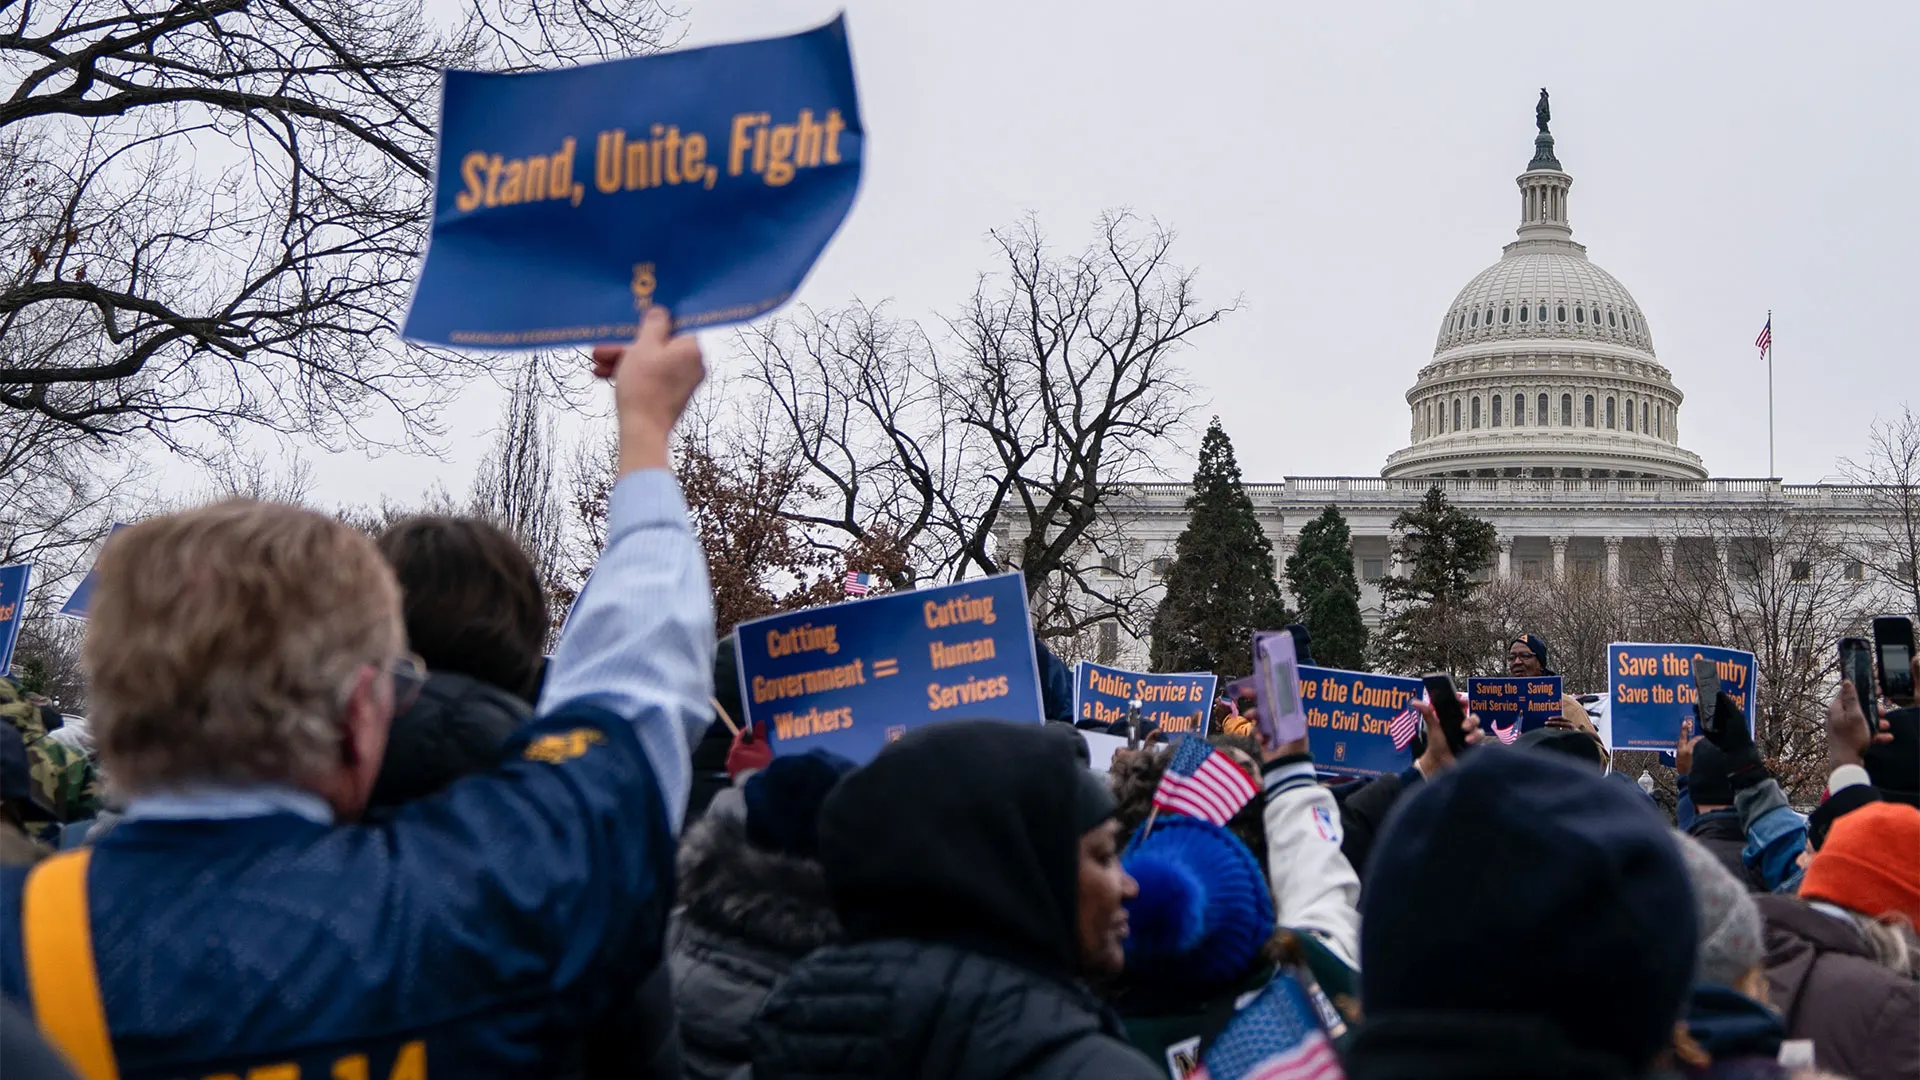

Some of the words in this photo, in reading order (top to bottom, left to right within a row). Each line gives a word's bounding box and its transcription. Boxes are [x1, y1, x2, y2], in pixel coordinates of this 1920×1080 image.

[456, 137, 584, 213] Stand,
[594, 123, 718, 194] Unite,
[728, 108, 846, 187] Fight
[923, 595, 997, 629] Cutting
[767, 623, 839, 658] Cutting
[928, 637, 996, 671] Human
[753, 658, 866, 703] Government
[1618, 652, 1658, 676] Save
[1661, 652, 1689, 677] the
[926, 674, 1009, 712] Services
[1089, 668, 1132, 700] Public
[1134, 679, 1186, 702] Service
[1189, 681, 1204, 702] is
[1299, 679, 1317, 700] ve
[1321, 677, 1348, 703] the
[1351, 680, 1413, 710] Countr
[1476, 682, 1503, 697] Saving
[1504, 682, 1518, 695] the
[1527, 682, 1554, 697] Saving
[1617, 683, 1649, 703] Save
[1651, 684, 1674, 704] the
[1676, 683, 1698, 705] Civ
[1083, 701, 1091, 719] a
[1094, 700, 1126, 725] Bad
[1158, 711, 1203, 733] Hono!
[1307, 707, 1329, 728] the
[1331, 709, 1360, 732] Civil
[1471, 699, 1487, 712] Civil
[1488, 699, 1518, 712] Service
[1527, 699, 1562, 712] America!
[773, 706, 854, 741] Workers
